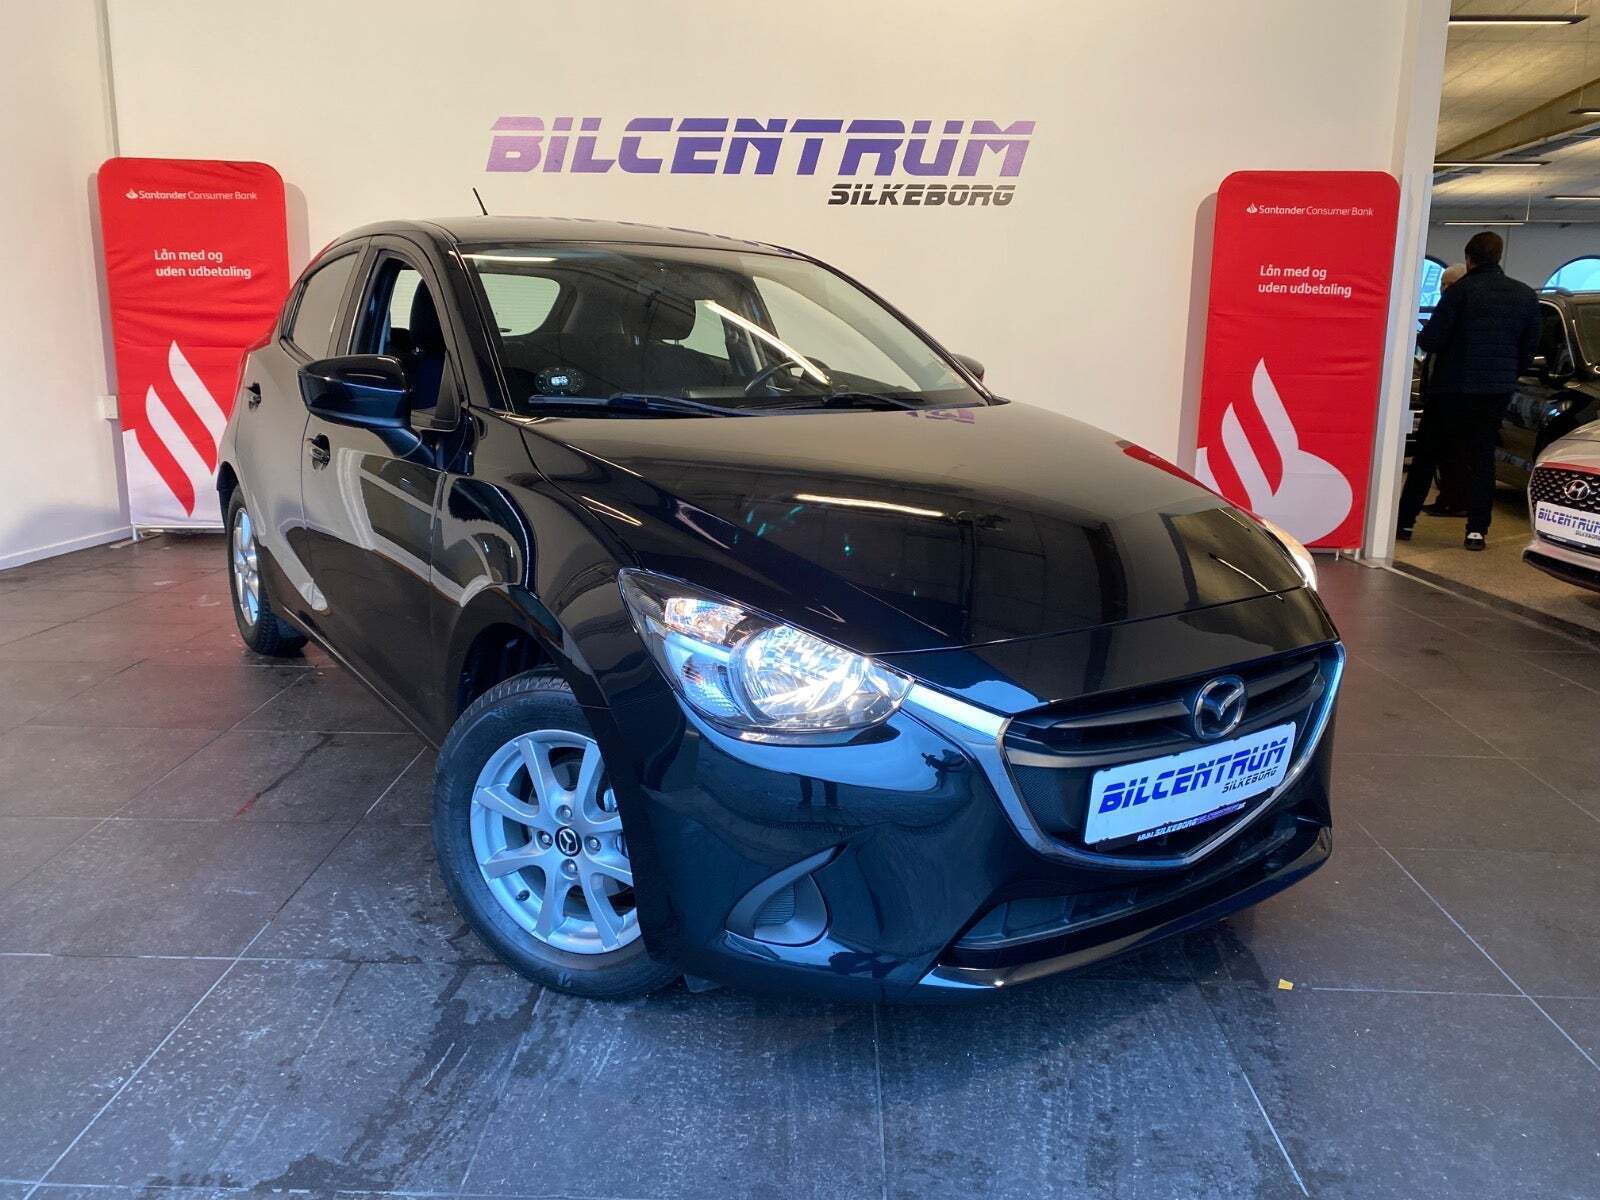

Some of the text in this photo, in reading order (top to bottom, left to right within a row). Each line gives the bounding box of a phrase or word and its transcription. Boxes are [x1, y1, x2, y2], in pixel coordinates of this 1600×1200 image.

[486, 117, 1036, 176] BILCENTRUM
[139, 190, 257, 201] Santander Consumer Bank
[828, 183, 1016, 206] SILKEBORG
[1258, 204, 1374, 217] Santander Consumer Bank
[154, 249, 223, 263] Lån med og
[155, 266, 252, 279] uden udbetaling
[1260, 264, 1327, 280] Lån med og
[1258, 282, 1352, 298] uden udbetaling
[1098, 737, 1288, 814] BILCENTRUM
[1221, 767, 1278, 794] SILKEBORG
